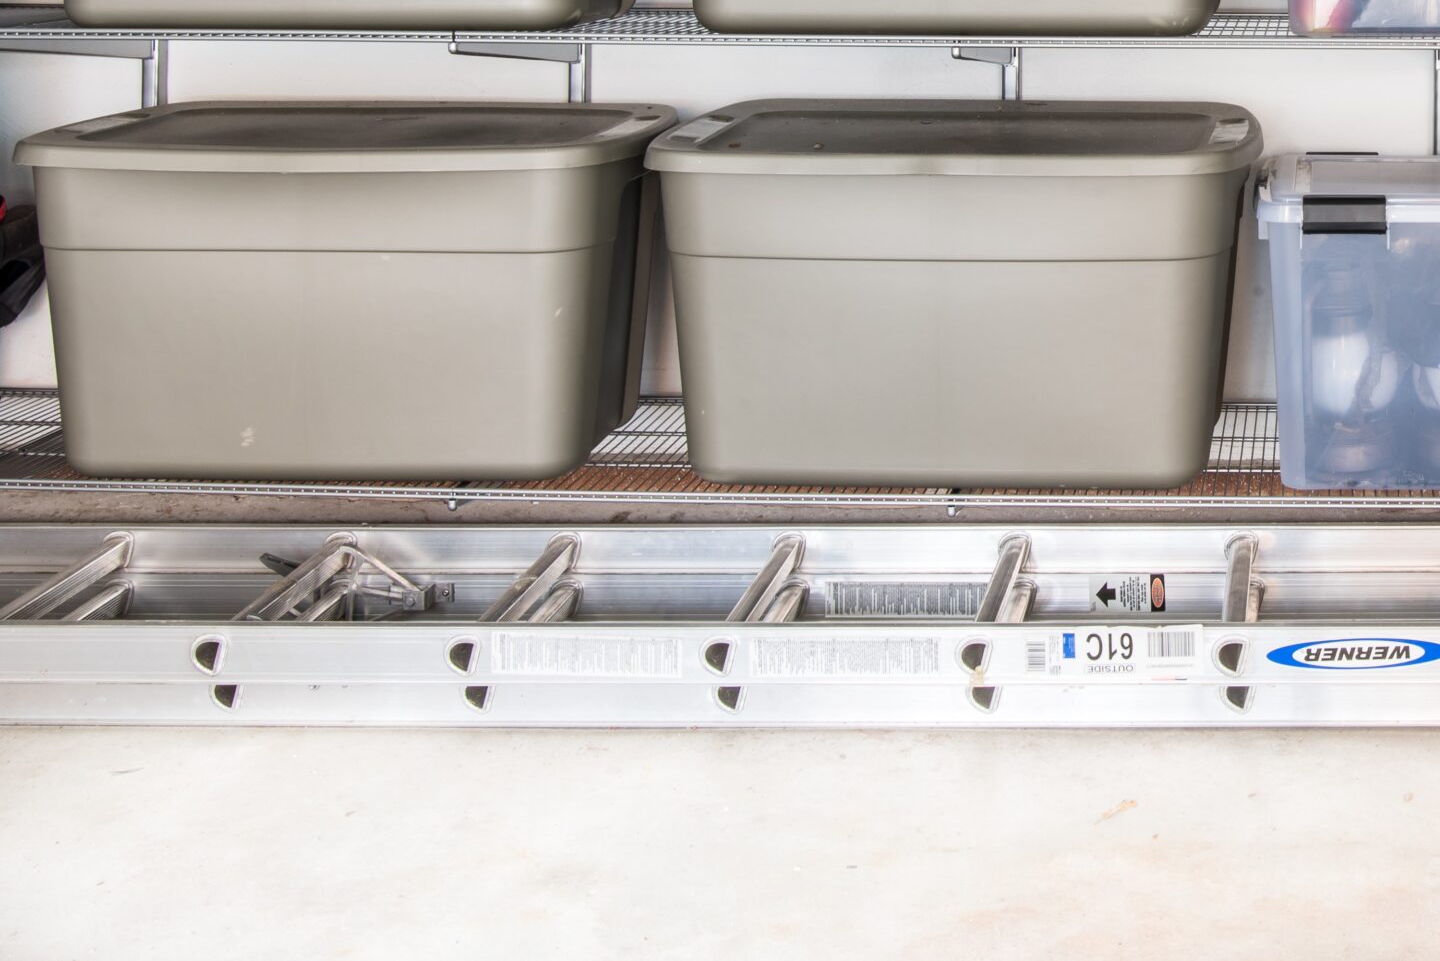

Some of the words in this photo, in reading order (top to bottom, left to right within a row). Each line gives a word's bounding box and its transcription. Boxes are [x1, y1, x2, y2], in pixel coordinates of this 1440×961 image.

[1086, 632, 1134, 661] 61C
[1304, 645, 1411, 662] WERNER
[1087, 664, 1134, 674] OUTSIDE
